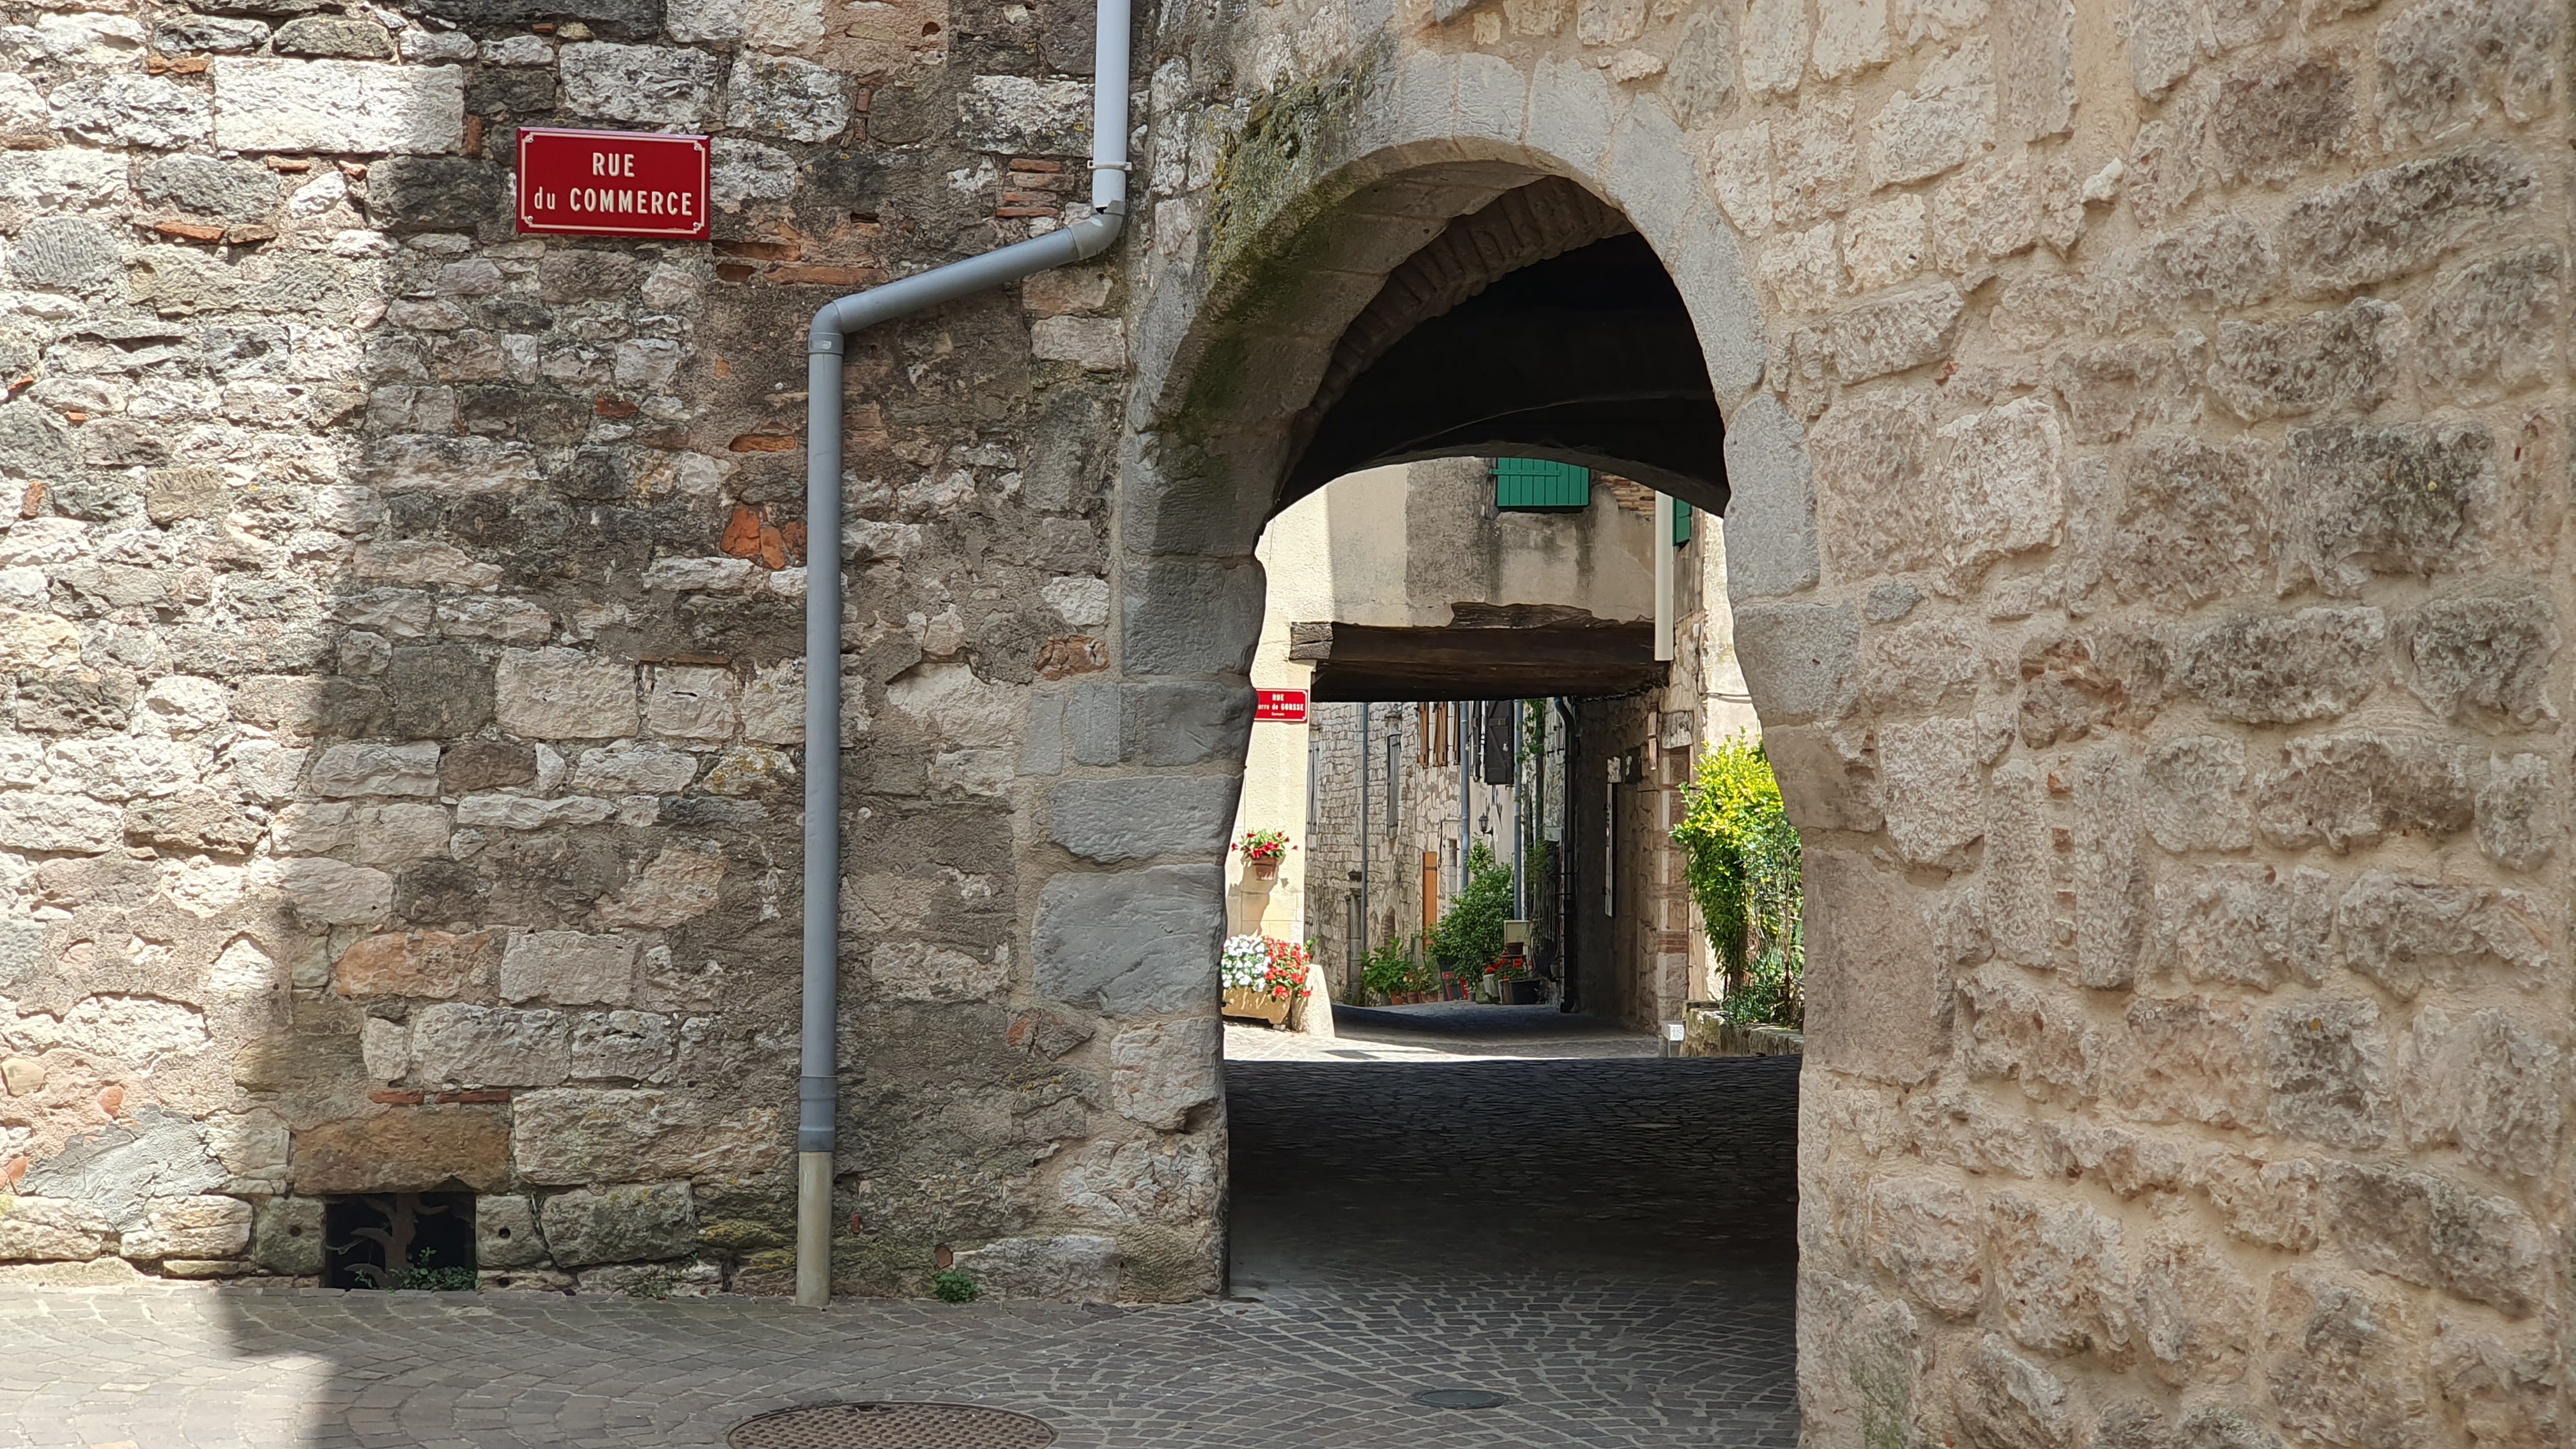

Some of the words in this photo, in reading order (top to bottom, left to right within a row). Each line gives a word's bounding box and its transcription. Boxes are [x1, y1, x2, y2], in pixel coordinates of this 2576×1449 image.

[592, 152, 635, 178] RUE
[534, 186, 556, 210] du
[570, 187, 693, 216] COMMERCE
